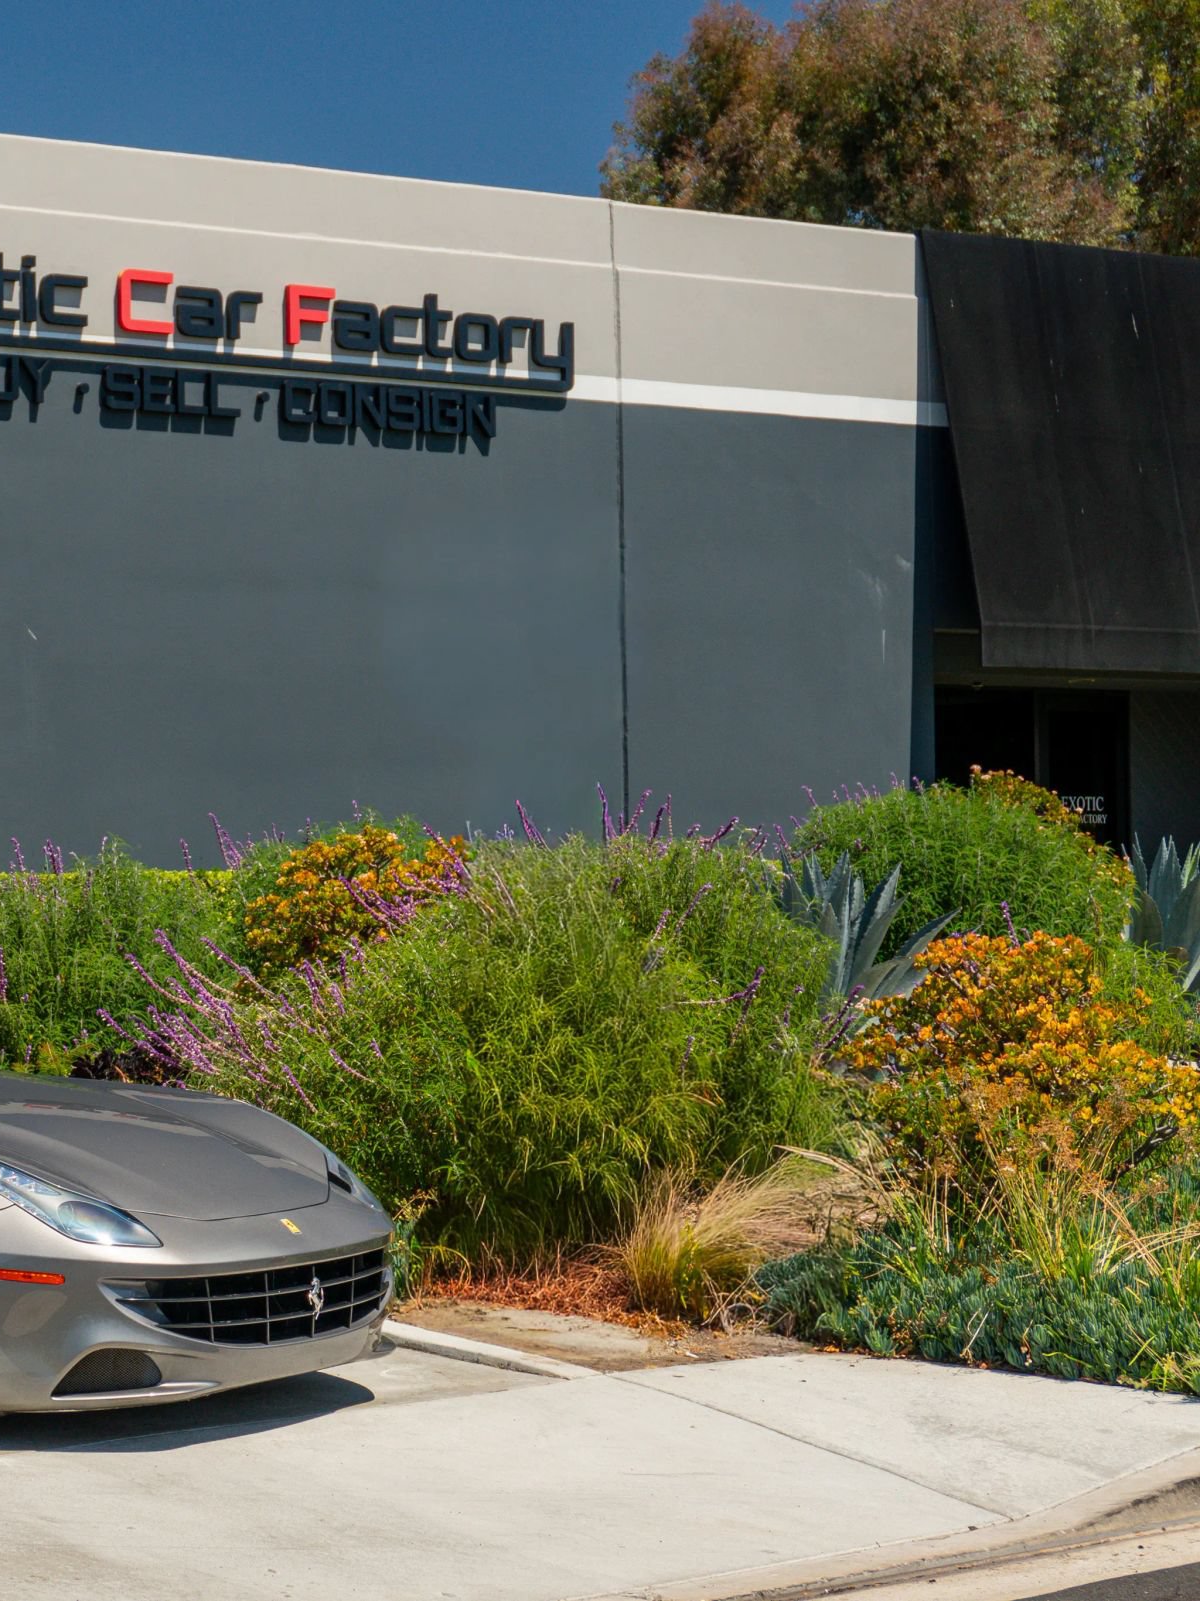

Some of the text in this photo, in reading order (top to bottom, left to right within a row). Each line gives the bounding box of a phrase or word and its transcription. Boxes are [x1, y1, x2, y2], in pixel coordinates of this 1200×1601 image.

[117, 269, 263, 339] Car
[285, 284, 575, 392] Factory
[104, 365, 241, 418] SELL
[284, 379, 497, 438] CONSIGN
[1061, 796, 1105, 812] EXOTIC
[1080, 814, 1108, 824] CTORY
